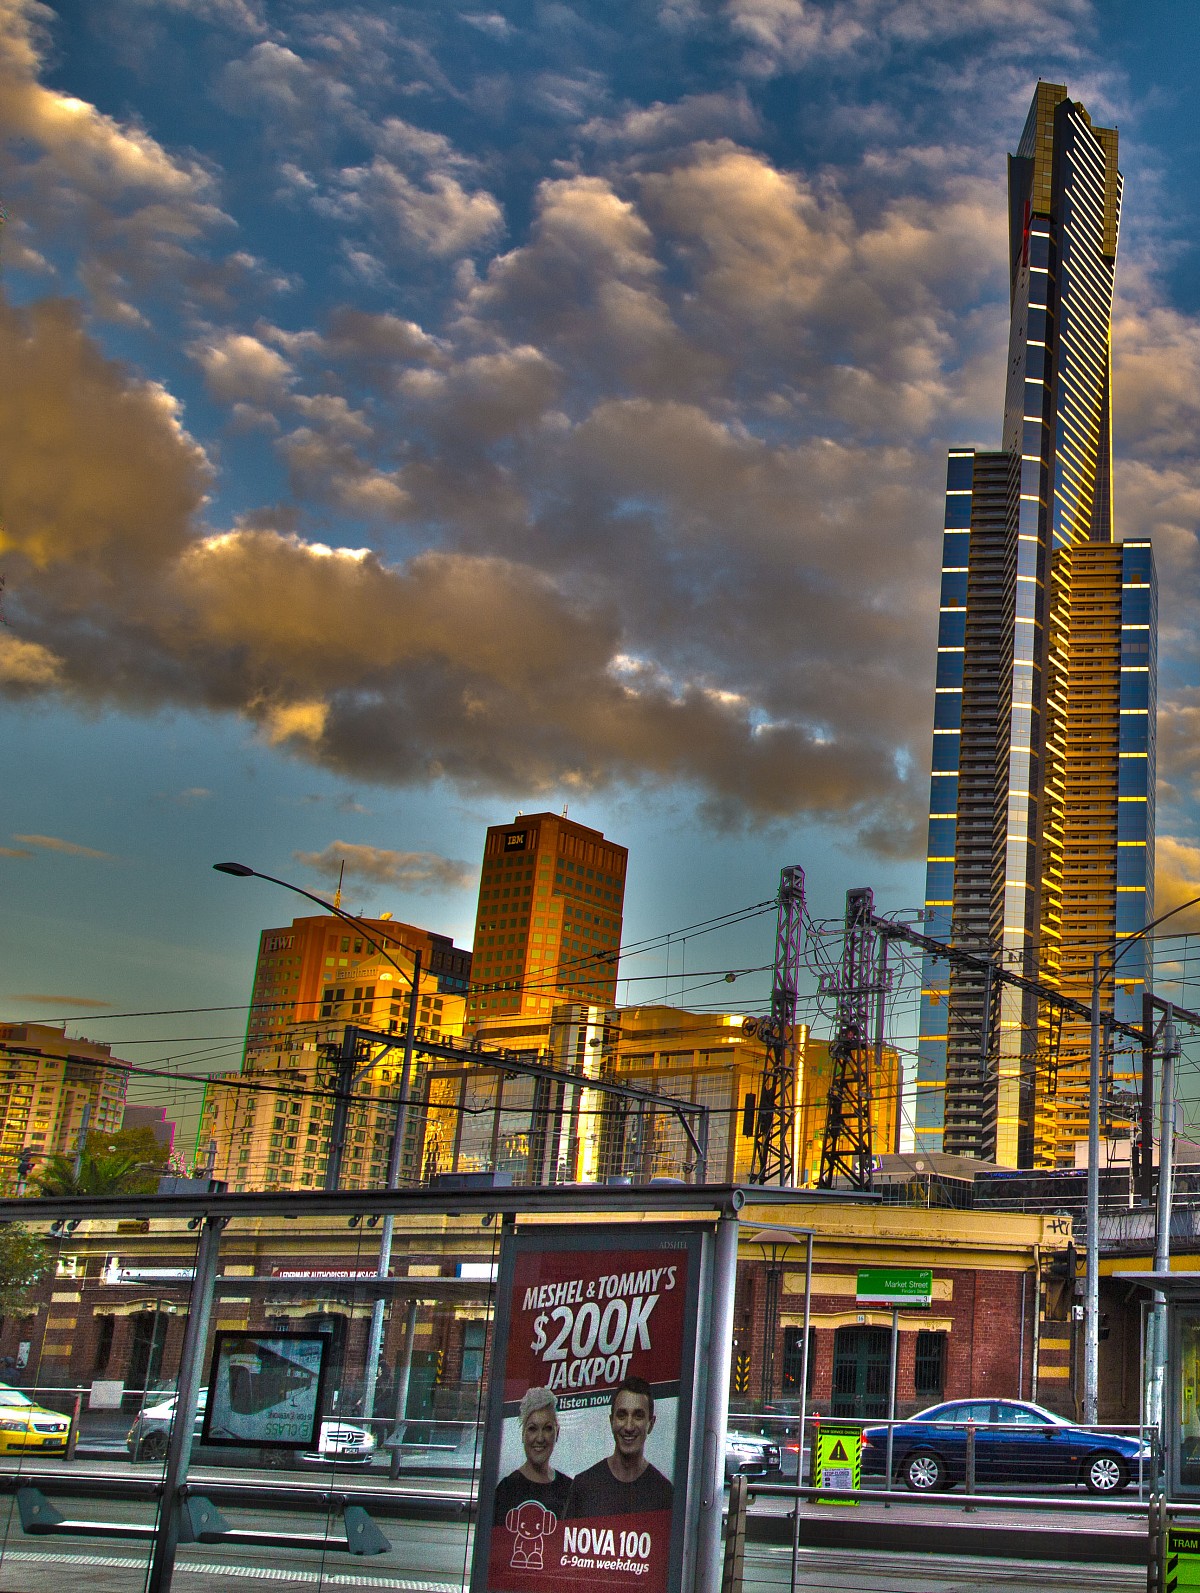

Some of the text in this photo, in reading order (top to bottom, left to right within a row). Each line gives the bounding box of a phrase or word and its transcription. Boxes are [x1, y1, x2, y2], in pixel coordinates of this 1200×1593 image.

[507, 835, 525, 846] IBM
[269, 935, 296, 951] HWT
[335, 967, 378, 980] Langham
[522, 1265, 677, 1311] MESHEL & TOMMY'S
[884, 1280, 928, 1289] Market Street
[530, 1294, 660, 1362] $200K
[544, 1353, 633, 1390] JACKPOT
[559, 1394, 612, 1410] listen now
[265, 1423, 298, 1438] CLASS
[563, 1526, 651, 1559] NOVA 100
[1173, 1539, 1198, 1549] TRAM
[560, 1555, 649, 1576] 6-9am weekdays
